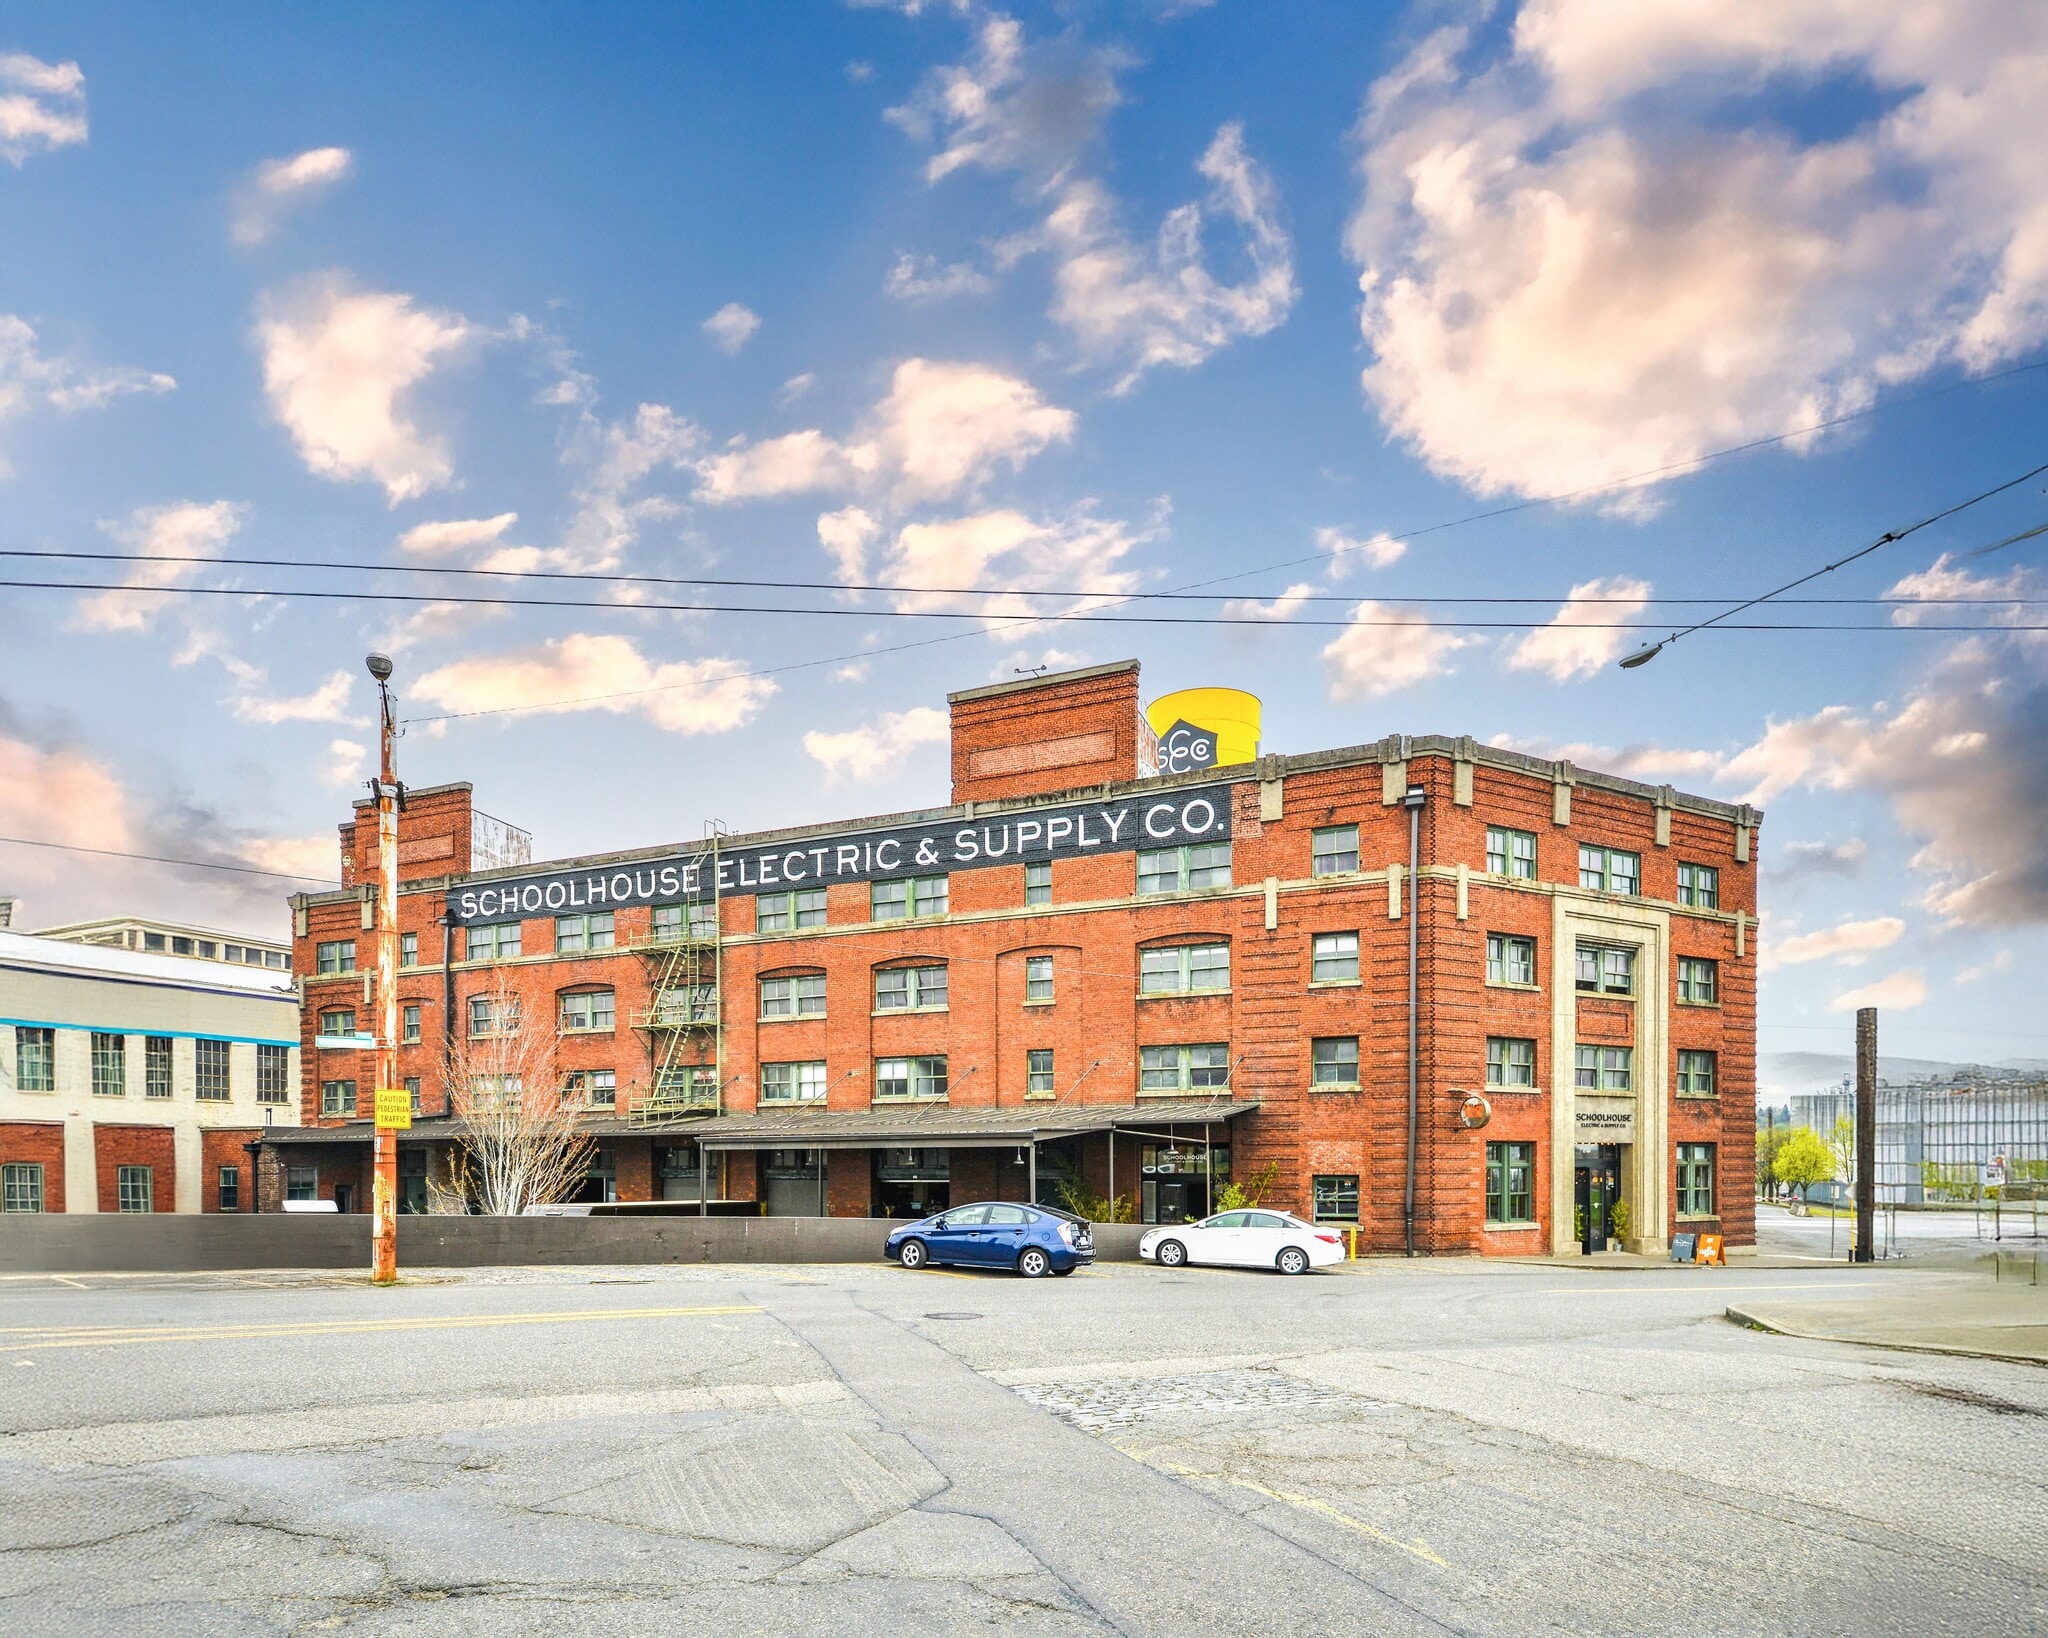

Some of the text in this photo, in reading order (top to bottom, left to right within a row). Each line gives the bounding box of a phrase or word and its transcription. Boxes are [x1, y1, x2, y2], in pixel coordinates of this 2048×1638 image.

[460, 799, 1225, 919] SCHOOLHOUSE ELECTRIC & SUPPLY CO.
[380, 1094, 407, 1103] CAUTION
[377, 1104, 409, 1113] PEDESTRIAN
[380, 1115, 406, 1123] TRAFFIC
[1575, 1113, 1632, 1122] SCHOOLHOUSE
